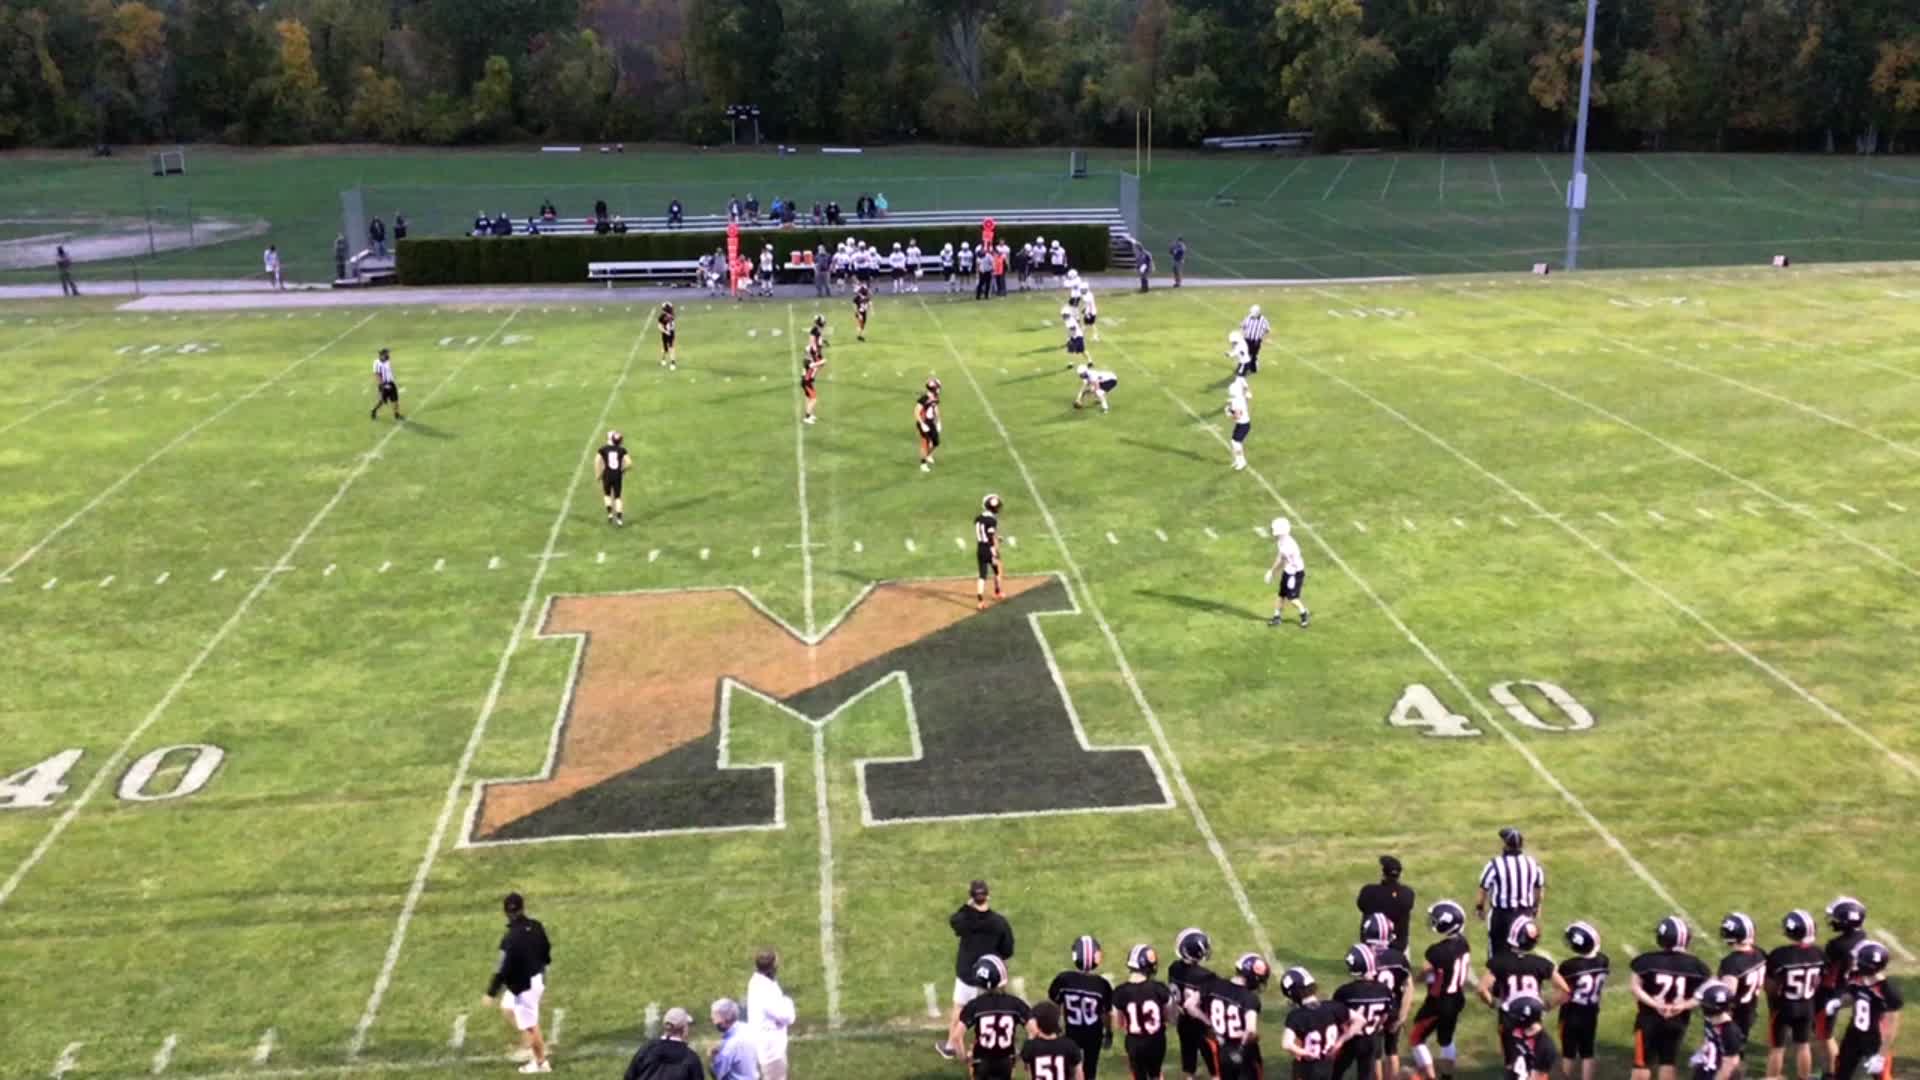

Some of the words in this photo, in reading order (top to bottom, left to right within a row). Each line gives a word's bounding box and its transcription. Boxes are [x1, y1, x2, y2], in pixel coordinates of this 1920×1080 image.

[457, 573, 1173, 848] M
[1389, 679, 1594, 736] 40
[0, 744, 225, 808] 40
[1655, 973, 1687, 1003] 71
[1785, 968, 1821, 999] 50
[1065, 994, 1098, 1025] 50
[1127, 1001, 1161, 1034] 13
[1210, 1001, 1244, 1038] 82
[1854, 999, 1870, 1031] 8
[979, 1016, 1014, 1049] 53
[1035, 1056, 1065, 1080] 51
